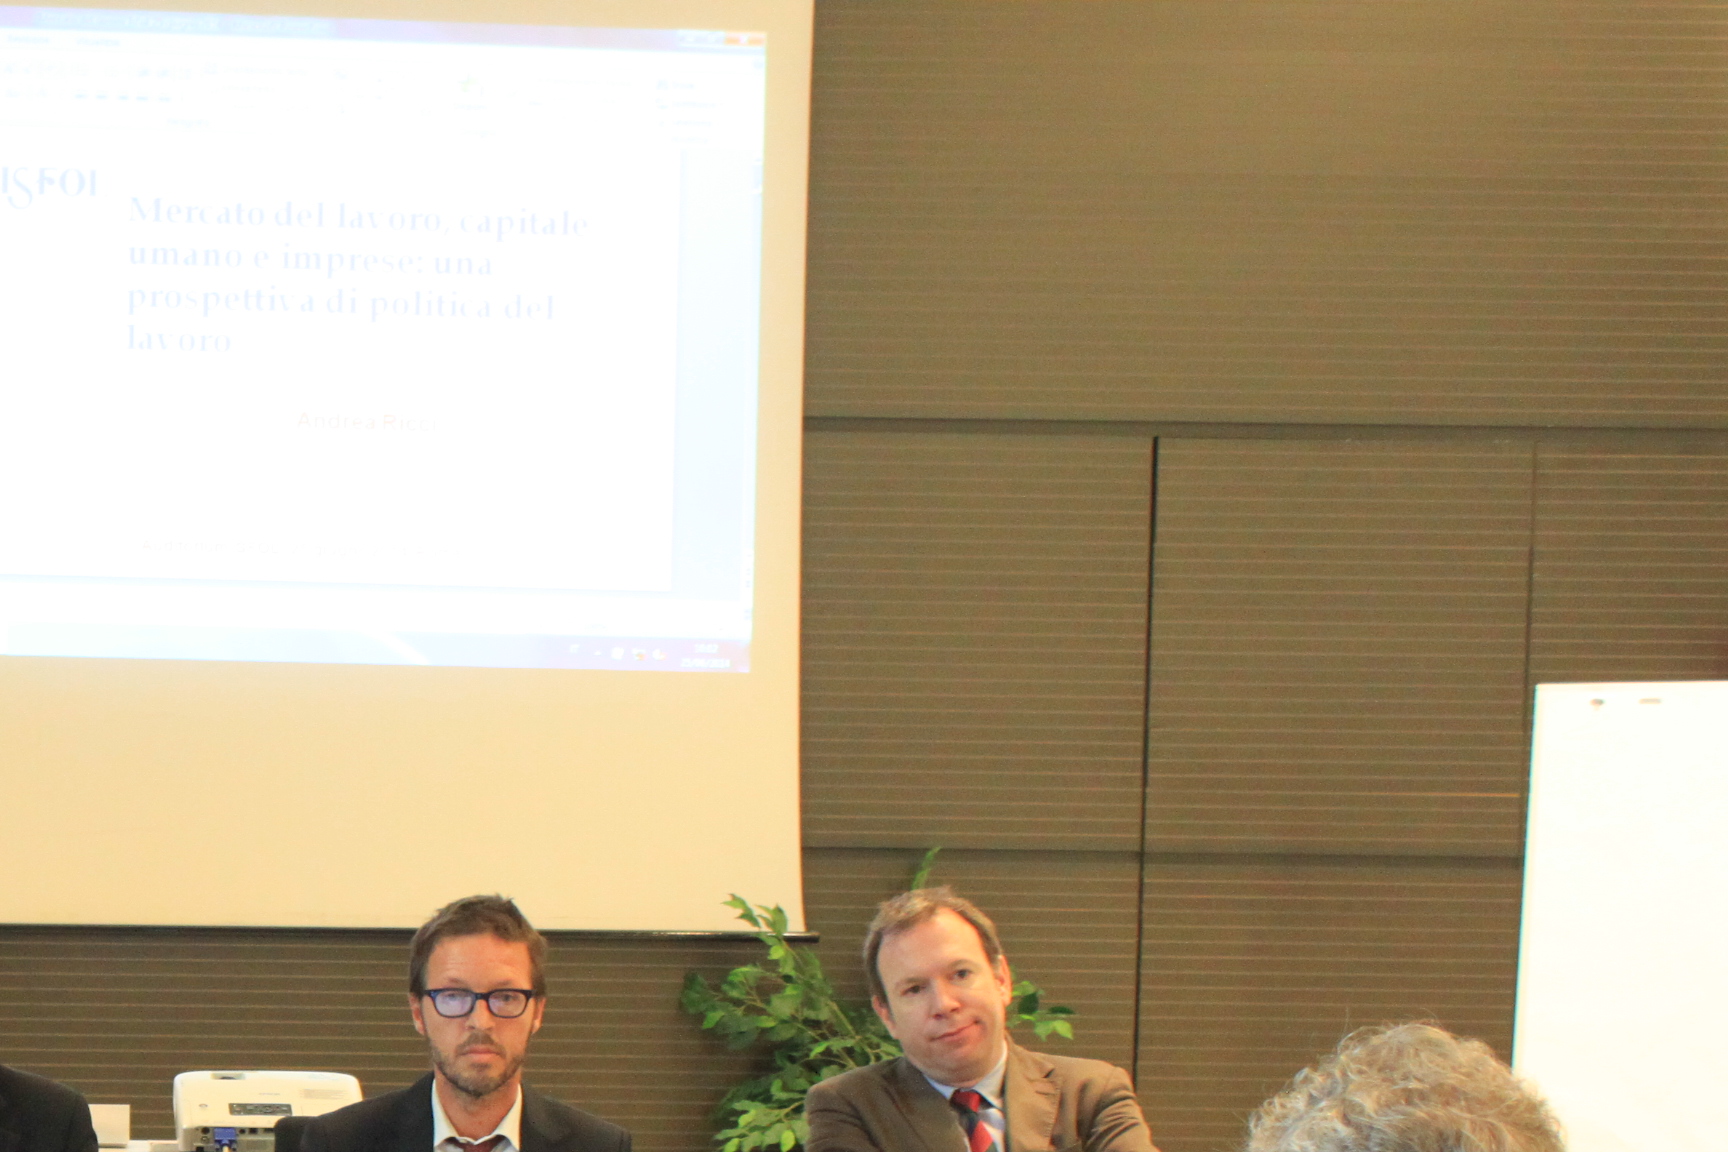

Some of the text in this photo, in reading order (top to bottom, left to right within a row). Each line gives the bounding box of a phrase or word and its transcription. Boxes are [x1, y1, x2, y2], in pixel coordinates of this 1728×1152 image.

[128, 196, 590, 242] Mercato del lavoro, capitale
[128, 243, 493, 279] umano e imprese: una
[127, 284, 555, 323] prospettiva di politica del
[127, 324, 232, 352] lavoro
[296, 411, 438, 433] Andrea Ricci
